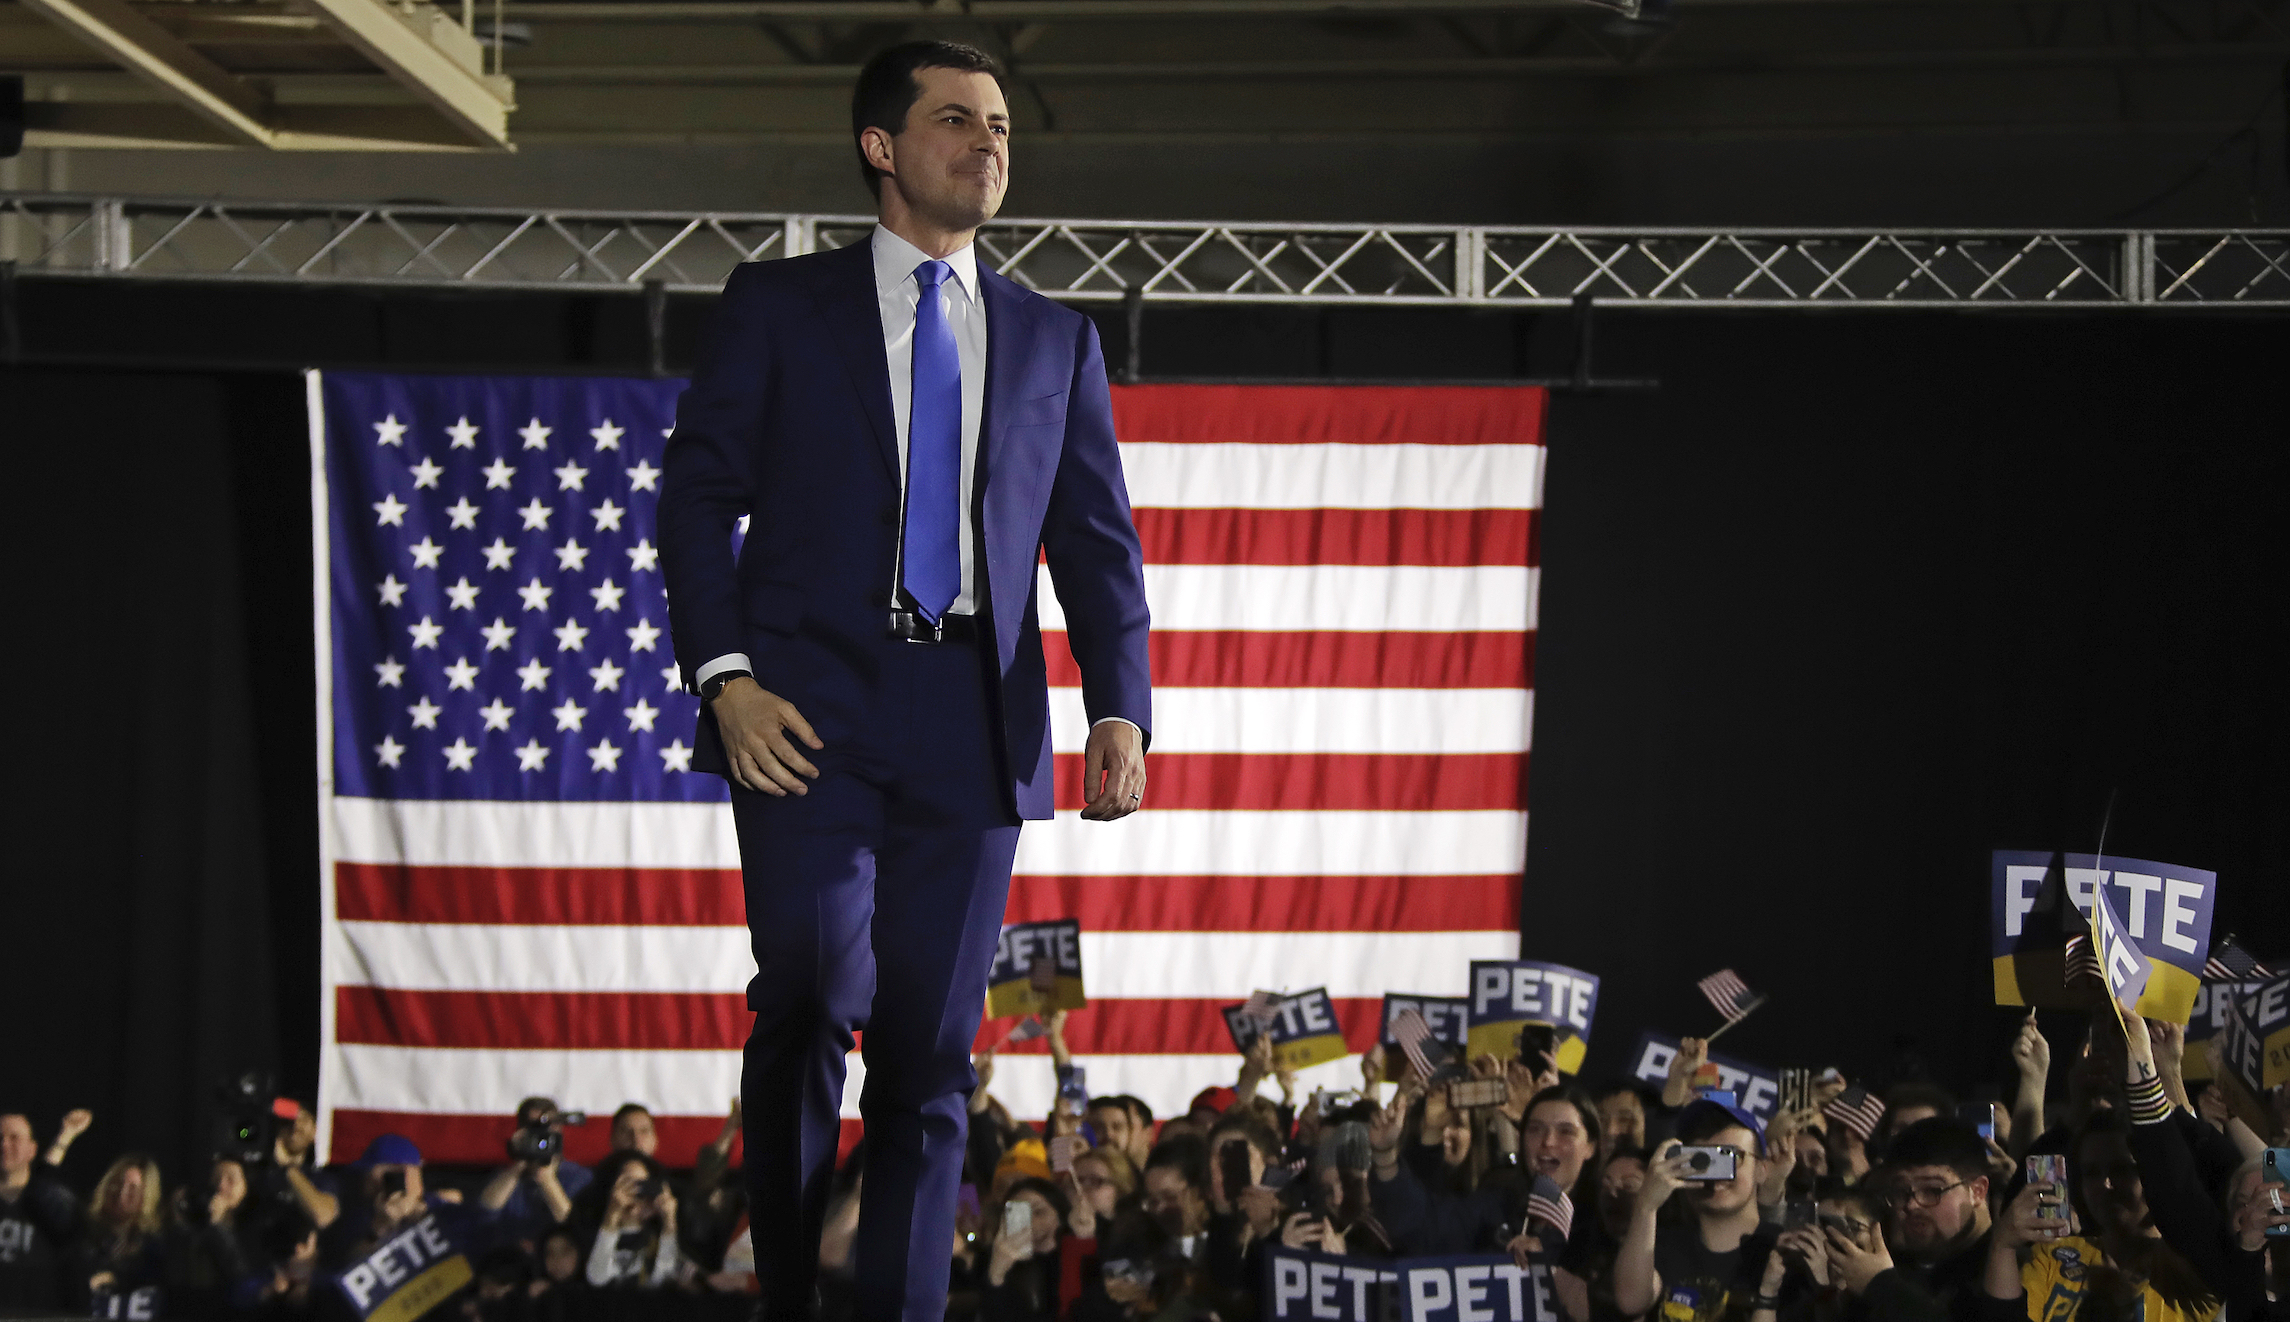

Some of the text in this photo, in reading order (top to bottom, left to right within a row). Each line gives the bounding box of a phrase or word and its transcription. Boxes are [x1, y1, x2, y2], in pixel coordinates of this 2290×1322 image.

[2005, 864, 2204, 955] PETE
[1475, 967, 1594, 1029] PETE
[1635, 1041, 1779, 1130] PTE
[342, 1213, 451, 1310] PETE
[1408, 1263, 1558, 1322] PETE
